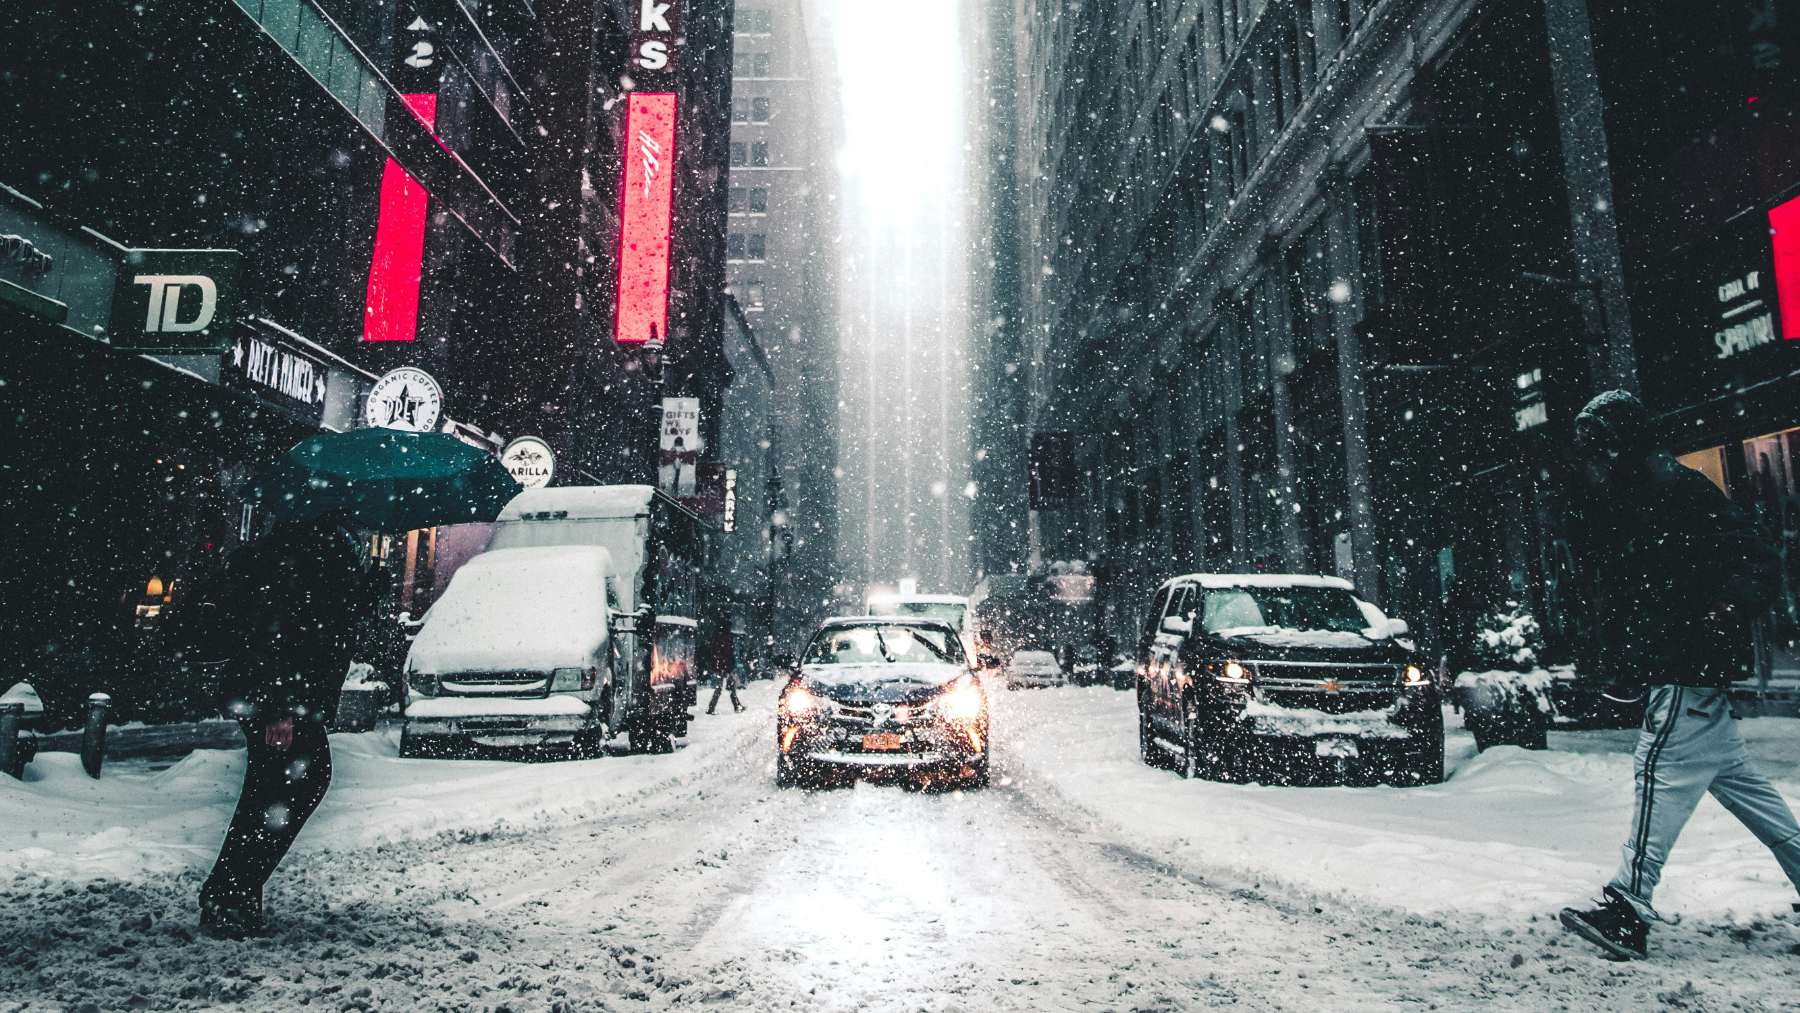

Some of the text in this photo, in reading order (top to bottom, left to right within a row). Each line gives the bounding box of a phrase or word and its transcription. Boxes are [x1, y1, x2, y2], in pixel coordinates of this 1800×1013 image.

[133, 275, 217, 332] TD
[370, 373, 439, 405] ORGANIC COFFEE
[384, 396, 424, 422] PRET
[665, 411, 696, 420] GIFTS
[510, 467, 549, 476] ARILLA
